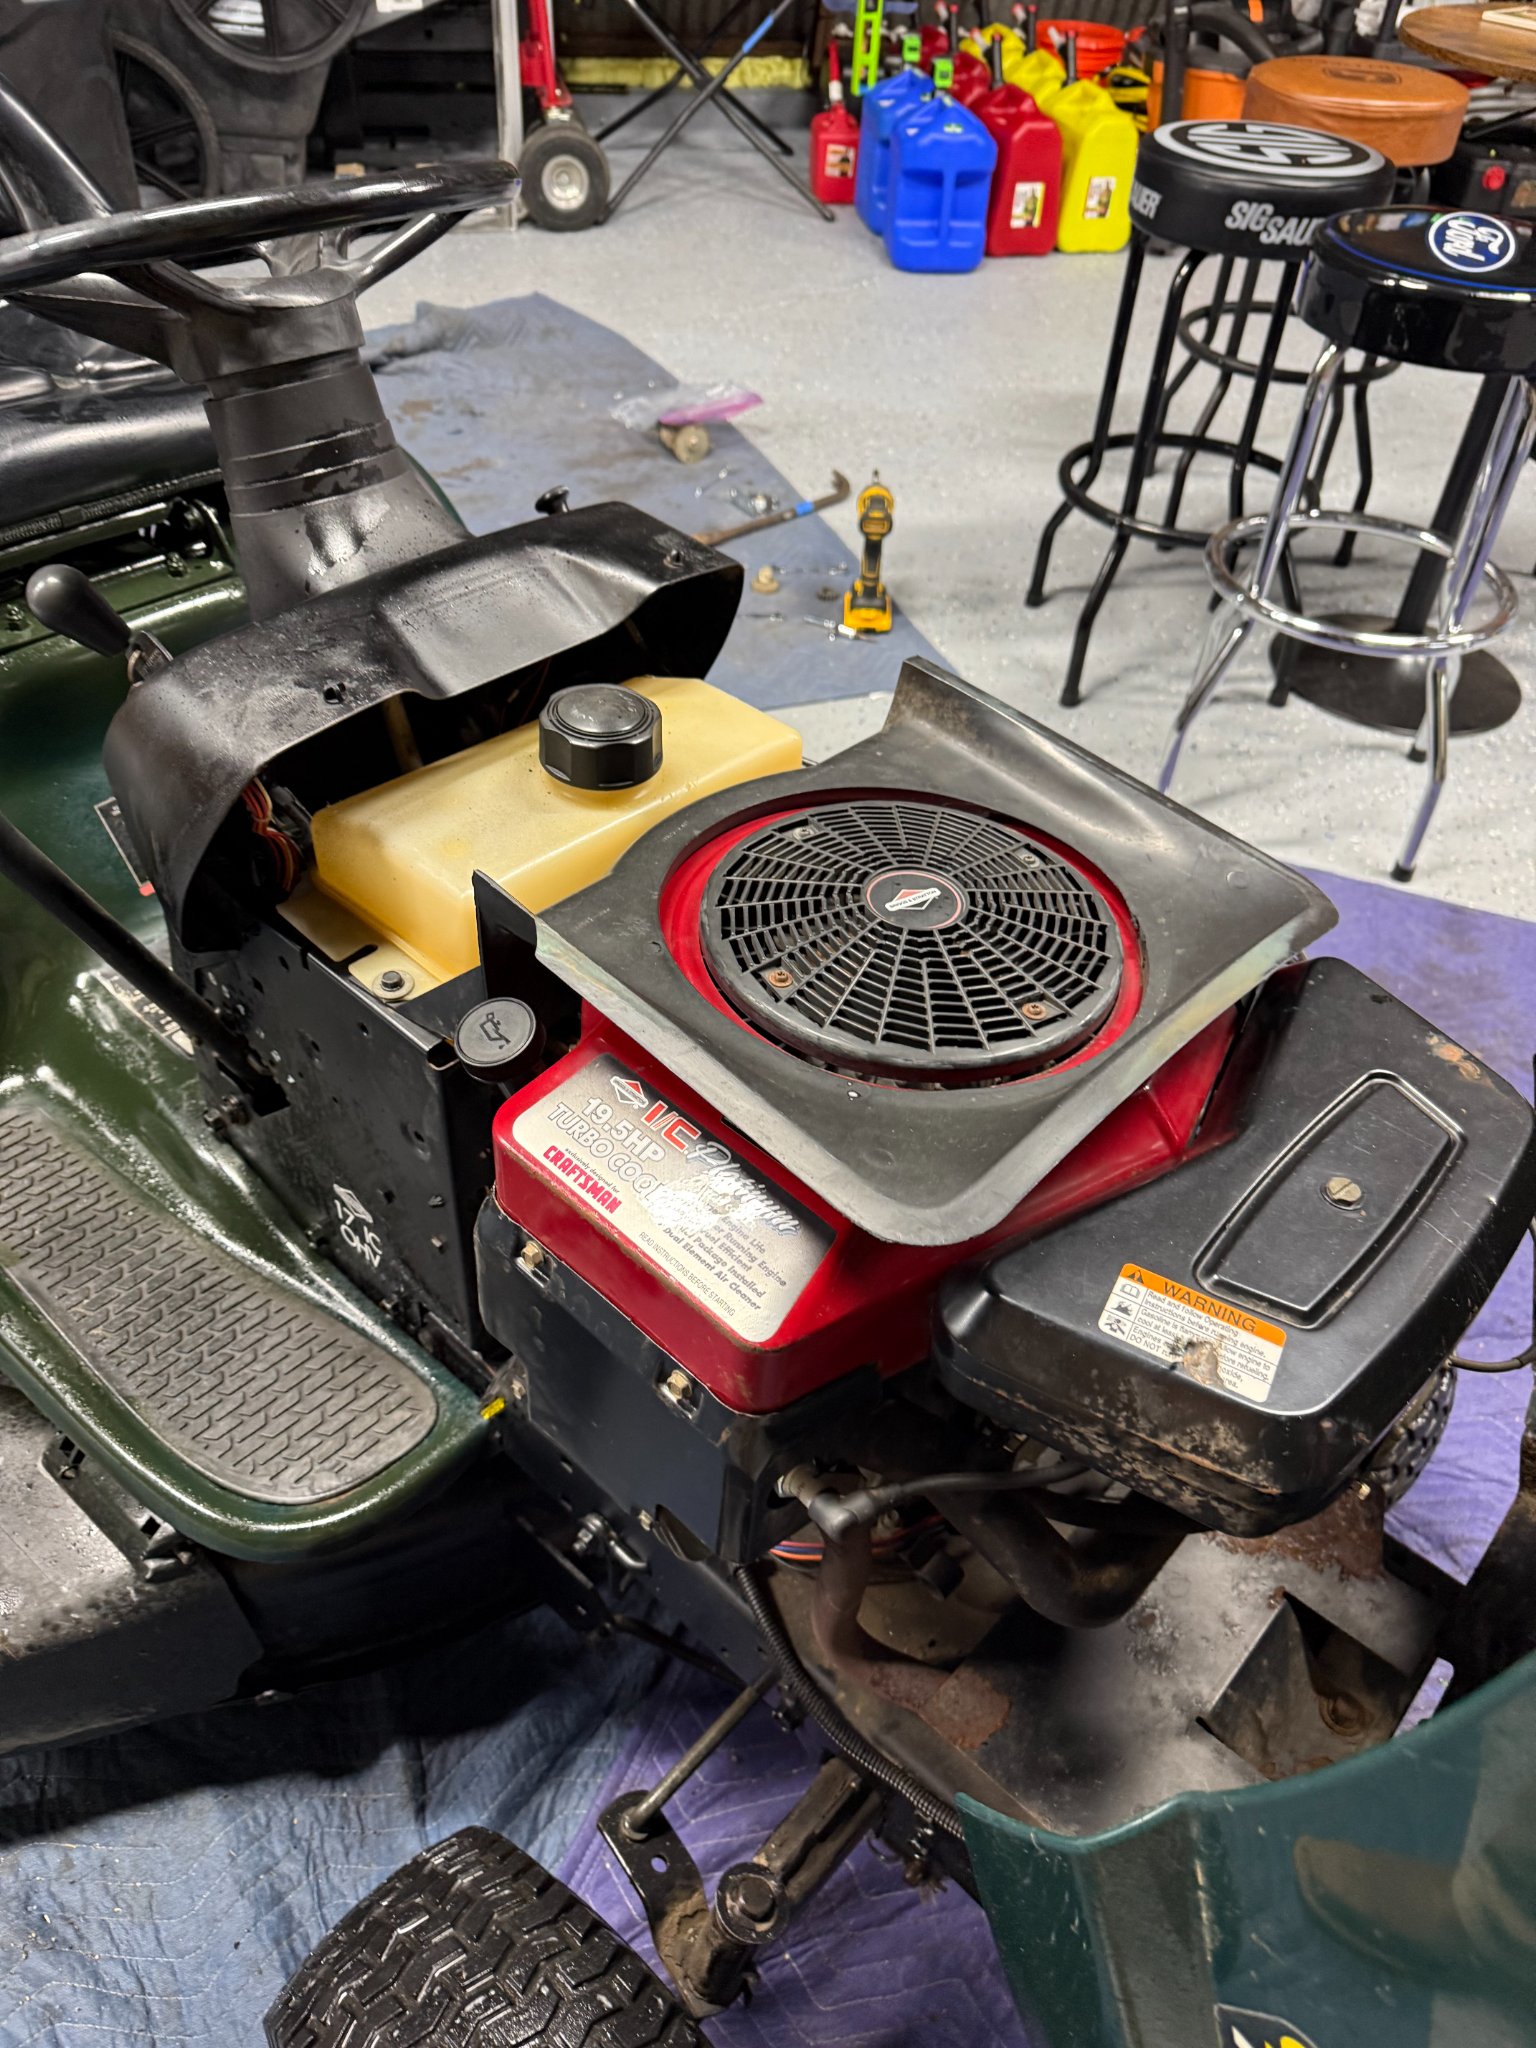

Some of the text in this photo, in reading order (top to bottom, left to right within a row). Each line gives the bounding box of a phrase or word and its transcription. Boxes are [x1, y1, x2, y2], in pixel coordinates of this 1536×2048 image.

[1131, 181, 1162, 219] AUER
[1225, 200, 1324, 246] SIG SAU
[1442, 219, 1504, 262] Ford
[547, 1102, 615, 1157] TURBO
[581, 1098, 662, 1161] 19.5HP
[542, 1144, 622, 1214] CRAFTSMAN
[588, 1167, 613, 1188] designed
[610, 1185, 621, 1194] for
[686, 1138, 799, 1235] Platinum
[717, 1242, 753, 1271] Efficient
[720, 1214, 751, 1240] Engine
[748, 1238, 767, 1253] Life
[638, 1230, 654, 1246] READ
[651, 1242, 690, 1277] INSTRUCTIONS
[686, 1272, 710, 1294] BEFORE
[707, 1290, 736, 1317] STARTING
[662, 1226, 683, 1243] Dual
[681, 1242, 716, 1270] Element
[713, 1269, 730, 1283] Air
[727, 1281, 763, 1310] Cleaner
[691, 1236, 766, 1297] Package Installed
[721, 1231, 759, 1263] Running
[755, 1260, 788, 1287] Engine
[1137, 1315, 1153, 1327] cool
[1153, 1322, 1161, 1331] at
[1144, 1298, 1186, 1321] Instructions
[1147, 1290, 1239, 1337] Read and follow Operating
[1165, 1281, 1257, 1332] WARNING
[1129, 1333, 1142, 1344] DO
[1142, 1339, 1161, 1352] NOT
[1132, 1325, 1162, 1344] Engines
[1140, 1307, 1171, 1327] Gasoline
[1171, 1321, 1178, 1329] is
[1236, 1351, 1262, 1368] engine
[1262, 1362, 1271, 1371] to
